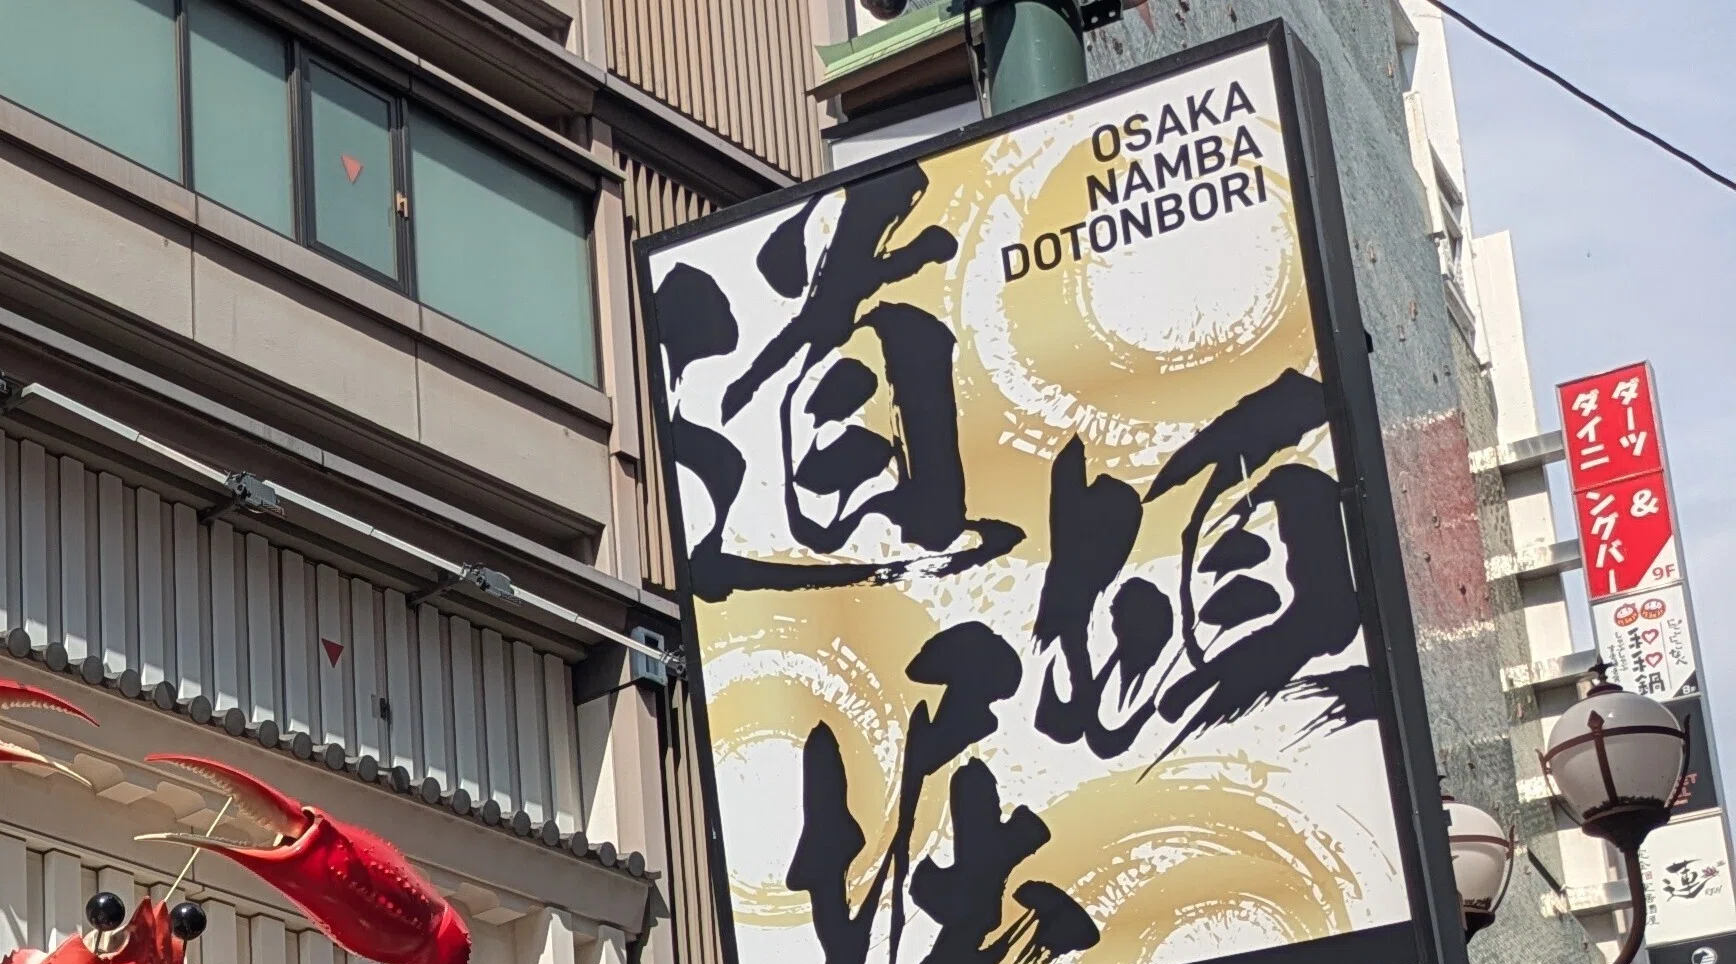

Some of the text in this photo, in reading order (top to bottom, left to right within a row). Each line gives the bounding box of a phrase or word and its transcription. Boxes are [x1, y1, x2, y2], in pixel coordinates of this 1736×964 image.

[1091, 80, 1257, 163] OSAKA
[1086, 125, 1264, 212] NAMBA
[1001, 165, 1268, 283] DOTONBORI
[1611, 377, 1659, 517] ダーツ &
[1652, 564, 1677, 581] 9F
